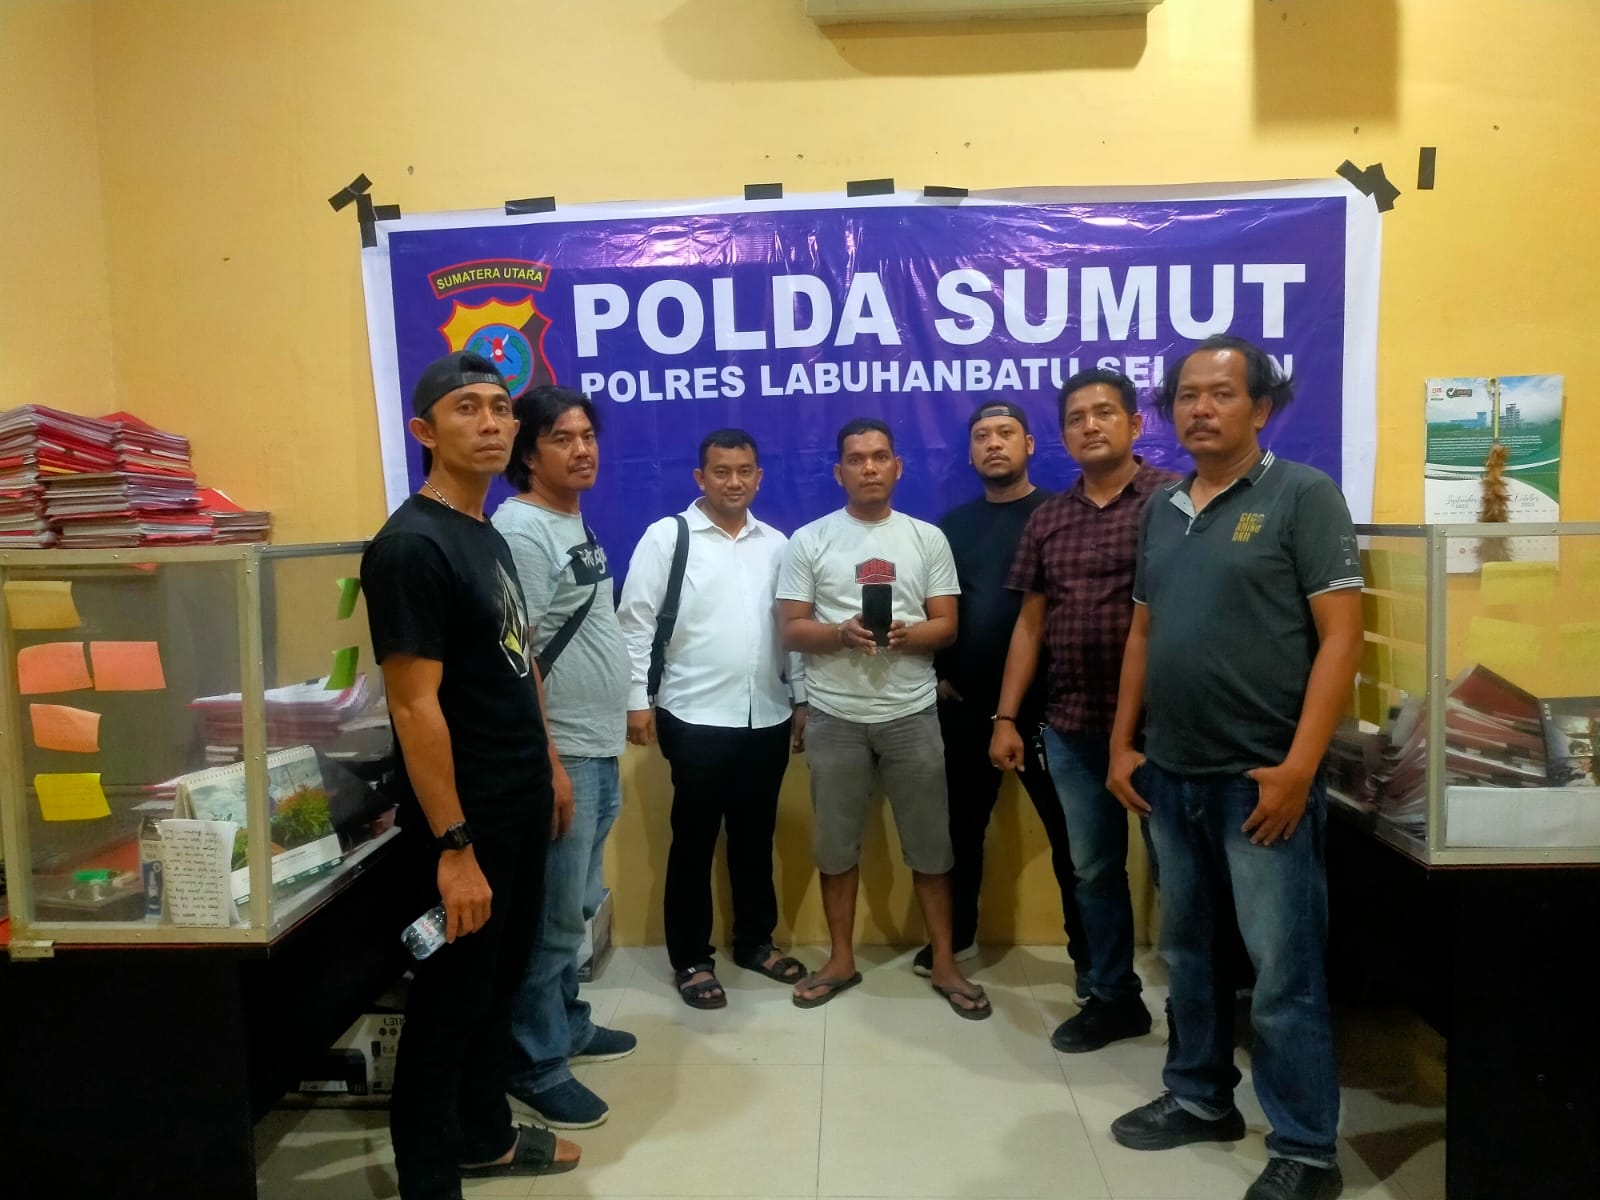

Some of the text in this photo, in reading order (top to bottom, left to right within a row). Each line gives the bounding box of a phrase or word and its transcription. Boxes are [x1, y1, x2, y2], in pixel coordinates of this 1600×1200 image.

[436, 267, 543, 289] SUMATERA UTARA
[573, 263, 1306, 357] POLDA SUMUT
[581, 365, 746, 402] POLRES
[760, 357, 1080, 396] LABUHANBATU
